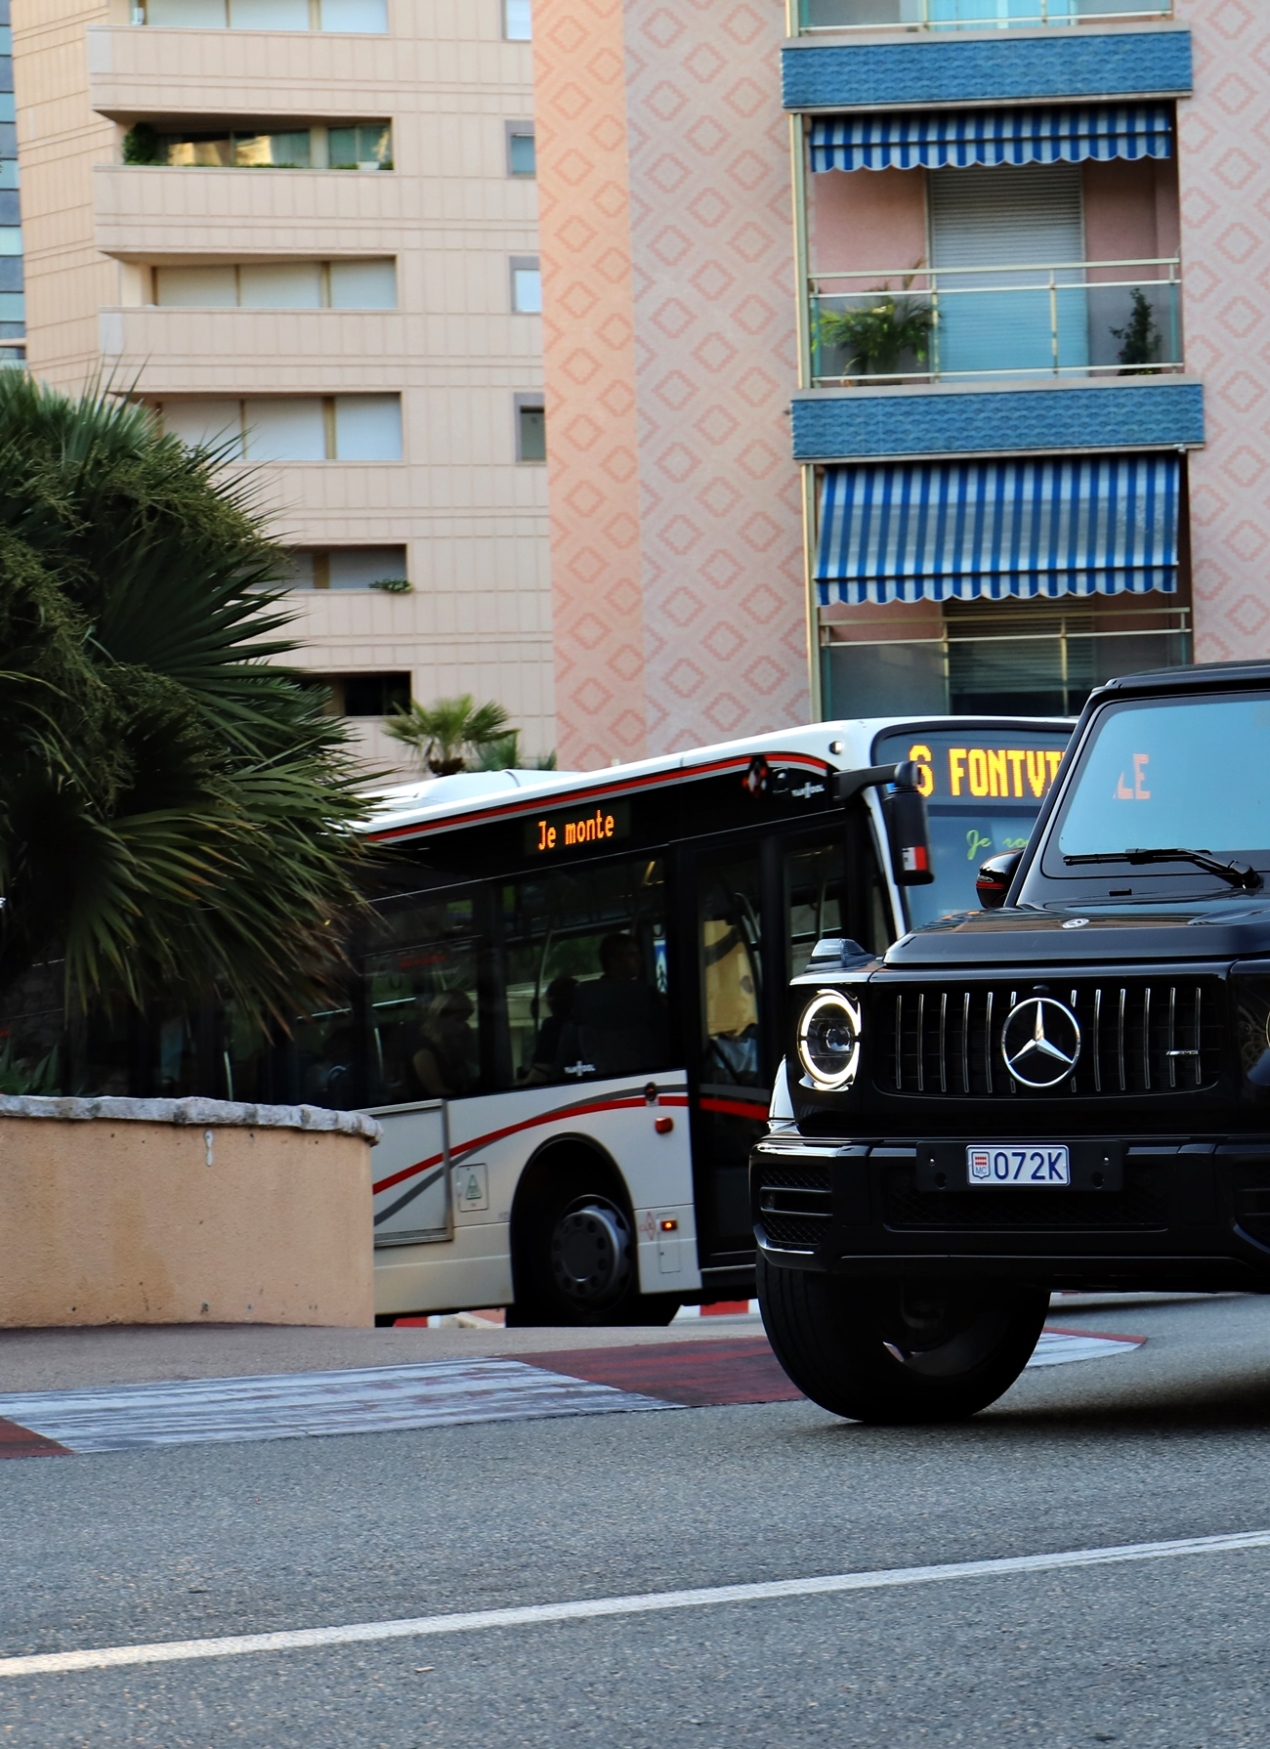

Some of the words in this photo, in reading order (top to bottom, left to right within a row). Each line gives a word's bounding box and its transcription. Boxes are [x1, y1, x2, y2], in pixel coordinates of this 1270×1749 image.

[538, 821, 556, 850] Je
[565, 810, 614, 845] monte
[966, 829, 991, 860] Je
[994, 1152, 1064, 1180] 072K
